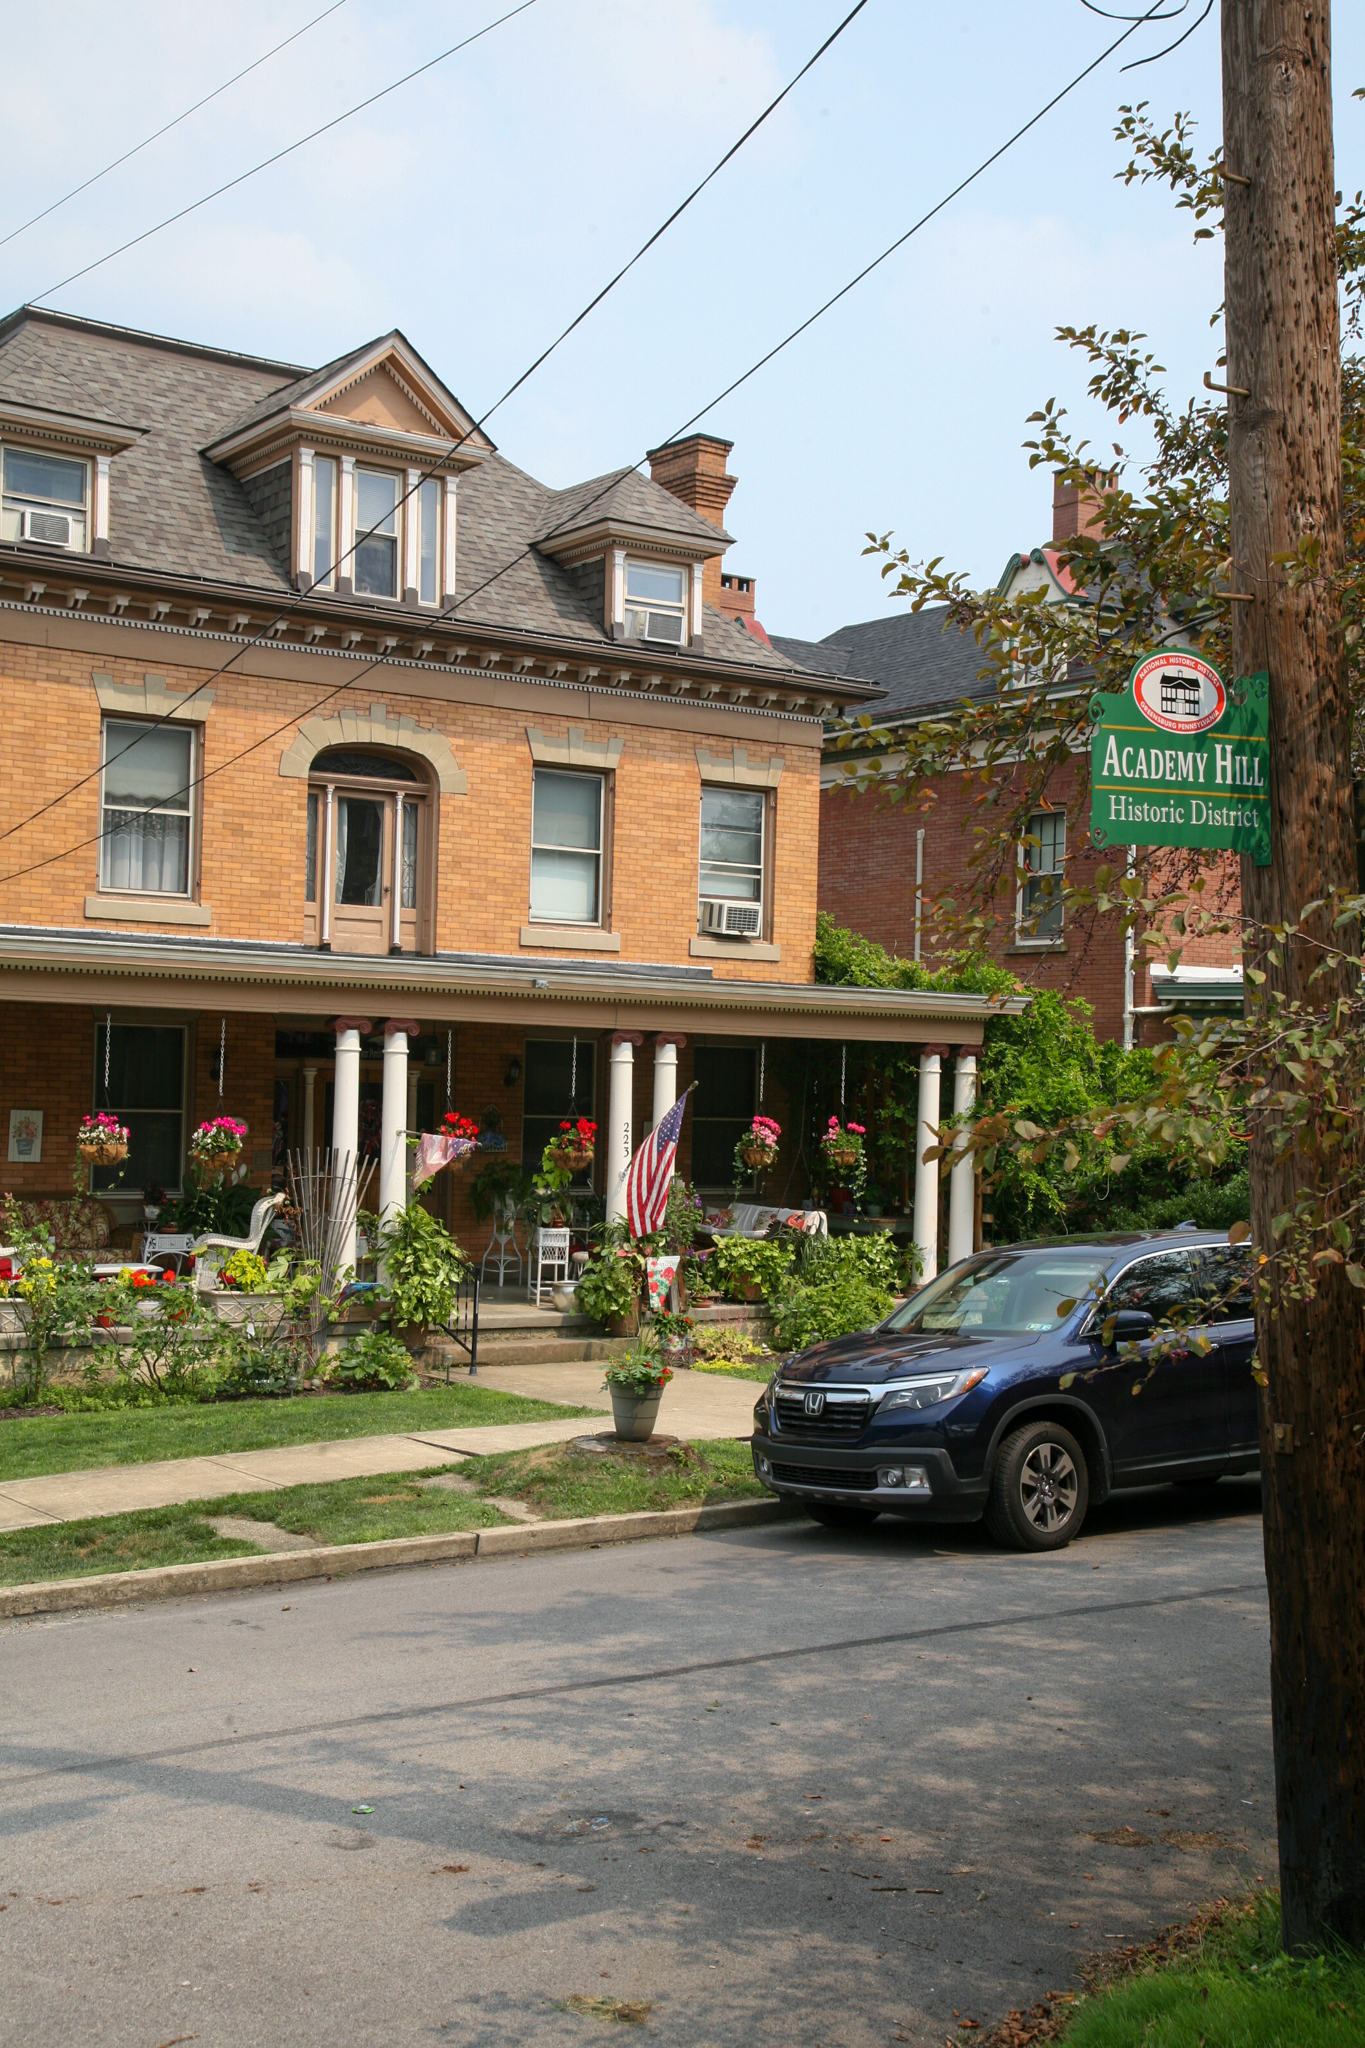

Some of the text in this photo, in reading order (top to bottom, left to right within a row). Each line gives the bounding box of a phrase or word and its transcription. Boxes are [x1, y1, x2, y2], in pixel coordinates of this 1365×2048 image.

[1139, 657, 1220, 687] NATIONAL HISTORIC DISTRICT
[1140, 701, 1220, 730] GREENSBURG PENNSYLVANIA
[1101, 734, 1264, 787] ACADEMY HILL
[1108, 794, 1259, 828] Historic District
